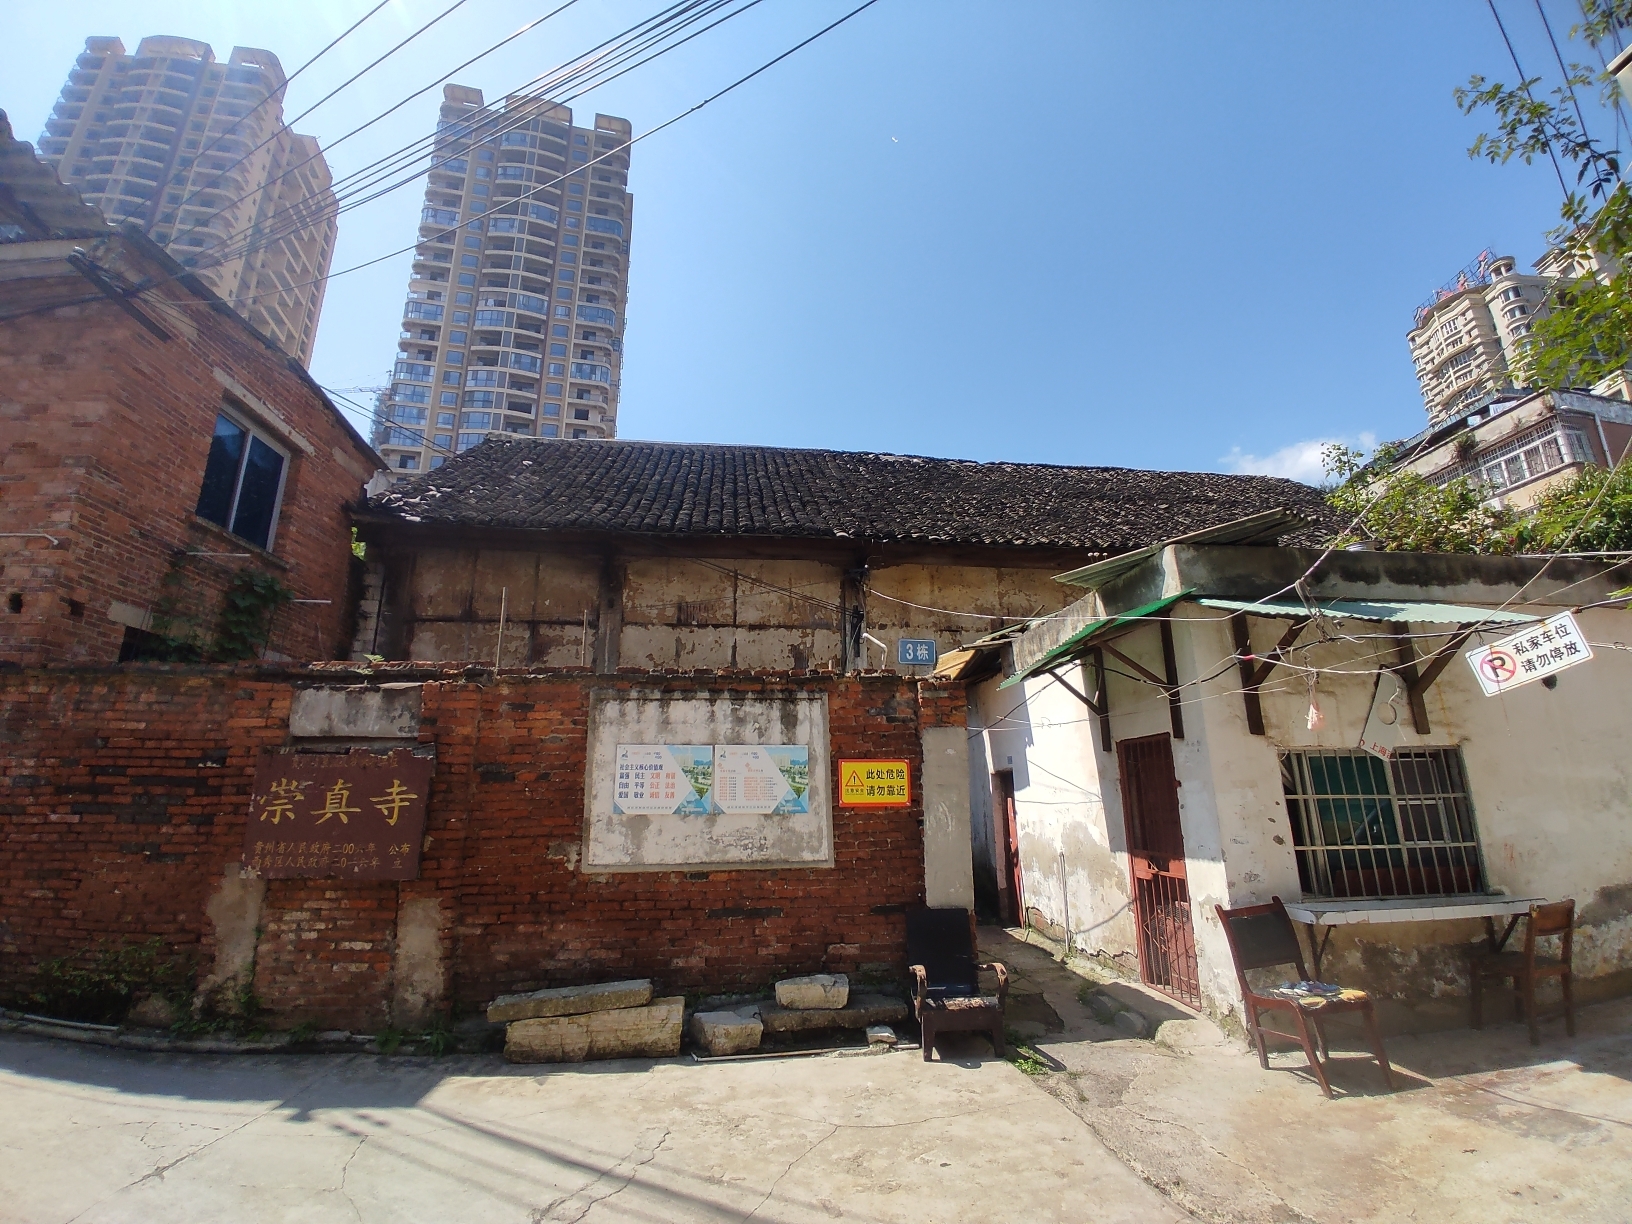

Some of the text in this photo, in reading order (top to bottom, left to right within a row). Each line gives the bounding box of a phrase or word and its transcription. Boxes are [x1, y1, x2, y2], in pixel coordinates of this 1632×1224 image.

[1512, 623, 1572, 656] 私家车位
[905, 643, 929, 661] 3栋
[1520, 640, 1581, 674] 请勿停放
[619, 763, 664, 771] 社会主义核心价值观
[618, 772, 630, 780] 富强
[634, 772, 645, 780] 民主
[649, 772, 660, 780] 文明
[865, 768, 905, 780] 此处危险
[618, 791, 675, 799] 爱国 敬业 诚信 友善
[866, 784, 906, 796] 请勿靠近
[259, 777, 418, 826] 崇真寺
[388, 842, 411, 856] 公布
